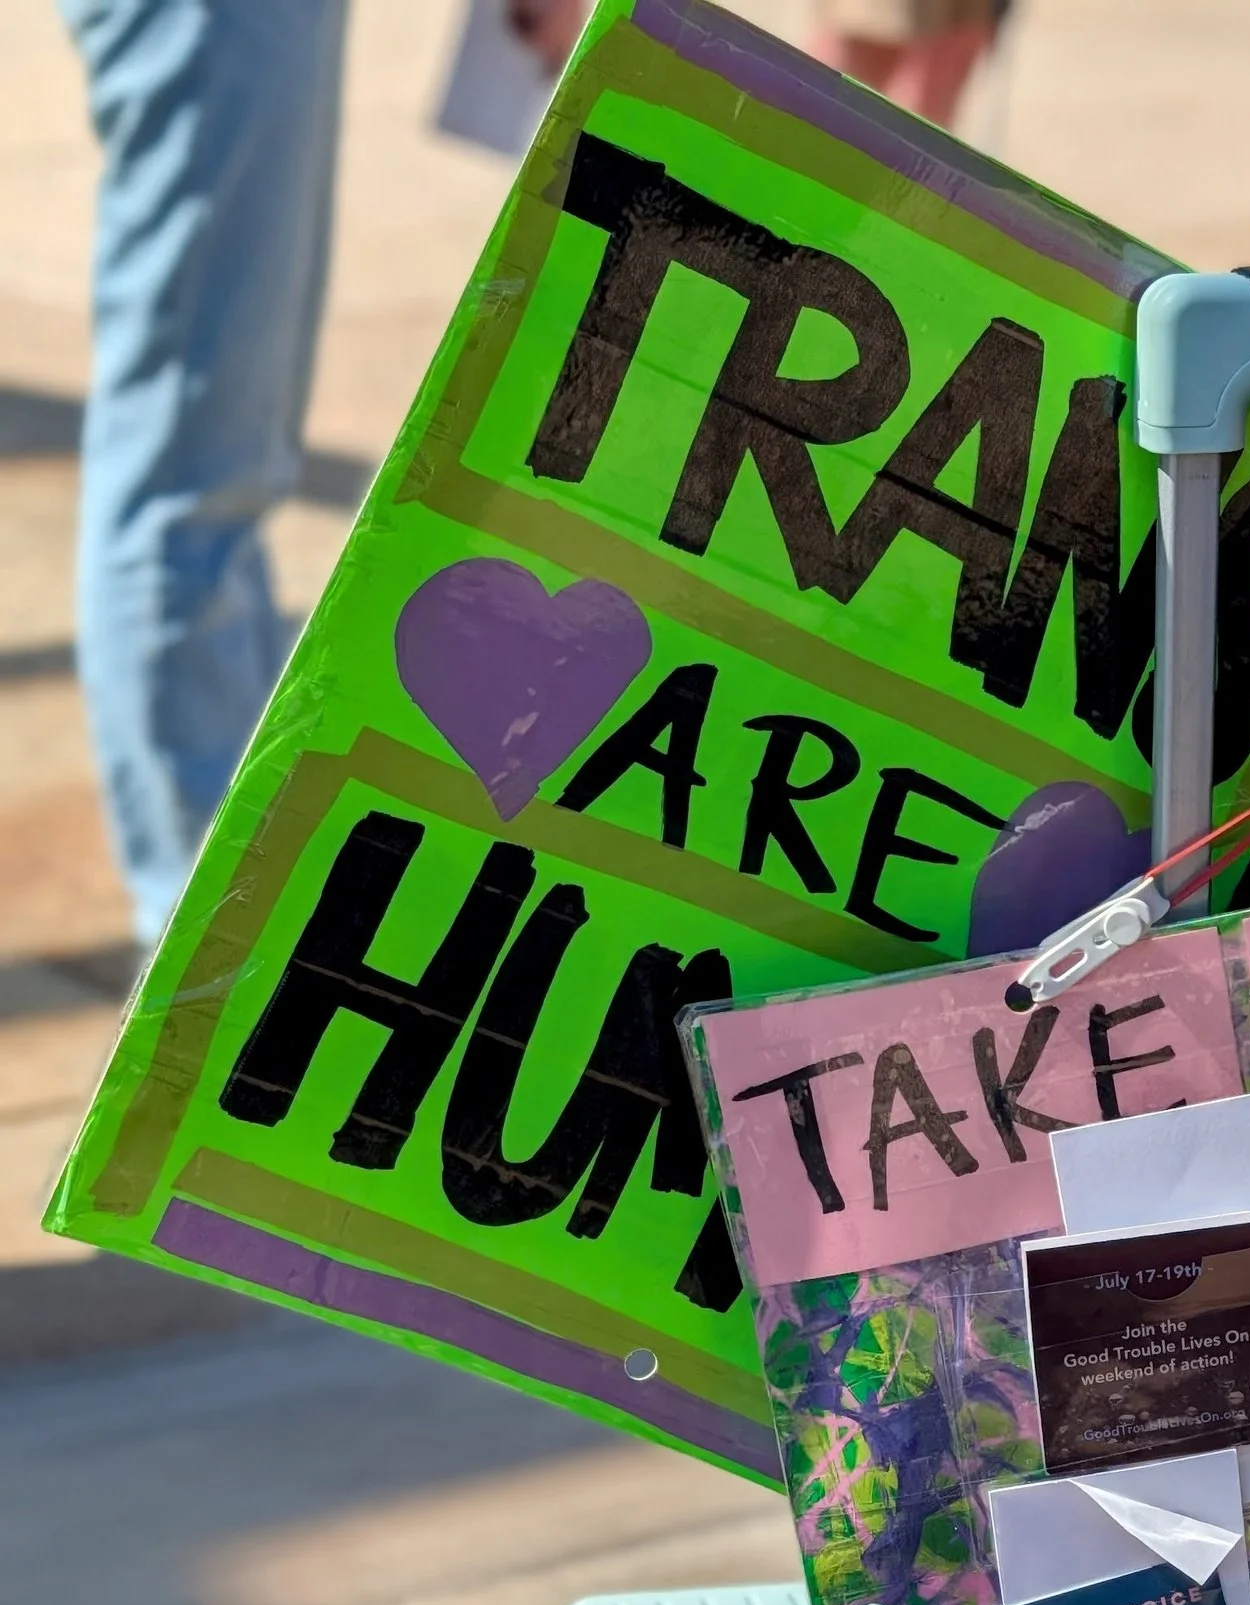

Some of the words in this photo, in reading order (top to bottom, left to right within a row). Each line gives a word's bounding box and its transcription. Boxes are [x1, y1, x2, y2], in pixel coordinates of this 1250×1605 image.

[555, 664, 1015, 942] ARE
[733, 995, 1187, 1213] TAKE
[1095, 1272, 1130, 1291] July
[1135, 1262, 1202, 1284] 17-19th
[1121, 1324, 1155, 1340] Join
[1160, 1320, 1187, 1335] the
[1064, 1347, 1109, 1368] Good
[1114, 1339, 1176, 1361] Trouble
[1181, 1335, 1221, 1350] Lives
[1225, 1330, 1250, 1344] On
[1081, 1358, 1153, 1386] weekend
[1160, 1358, 1176, 1374] of
[1180, 1350, 1235, 1369] action!
